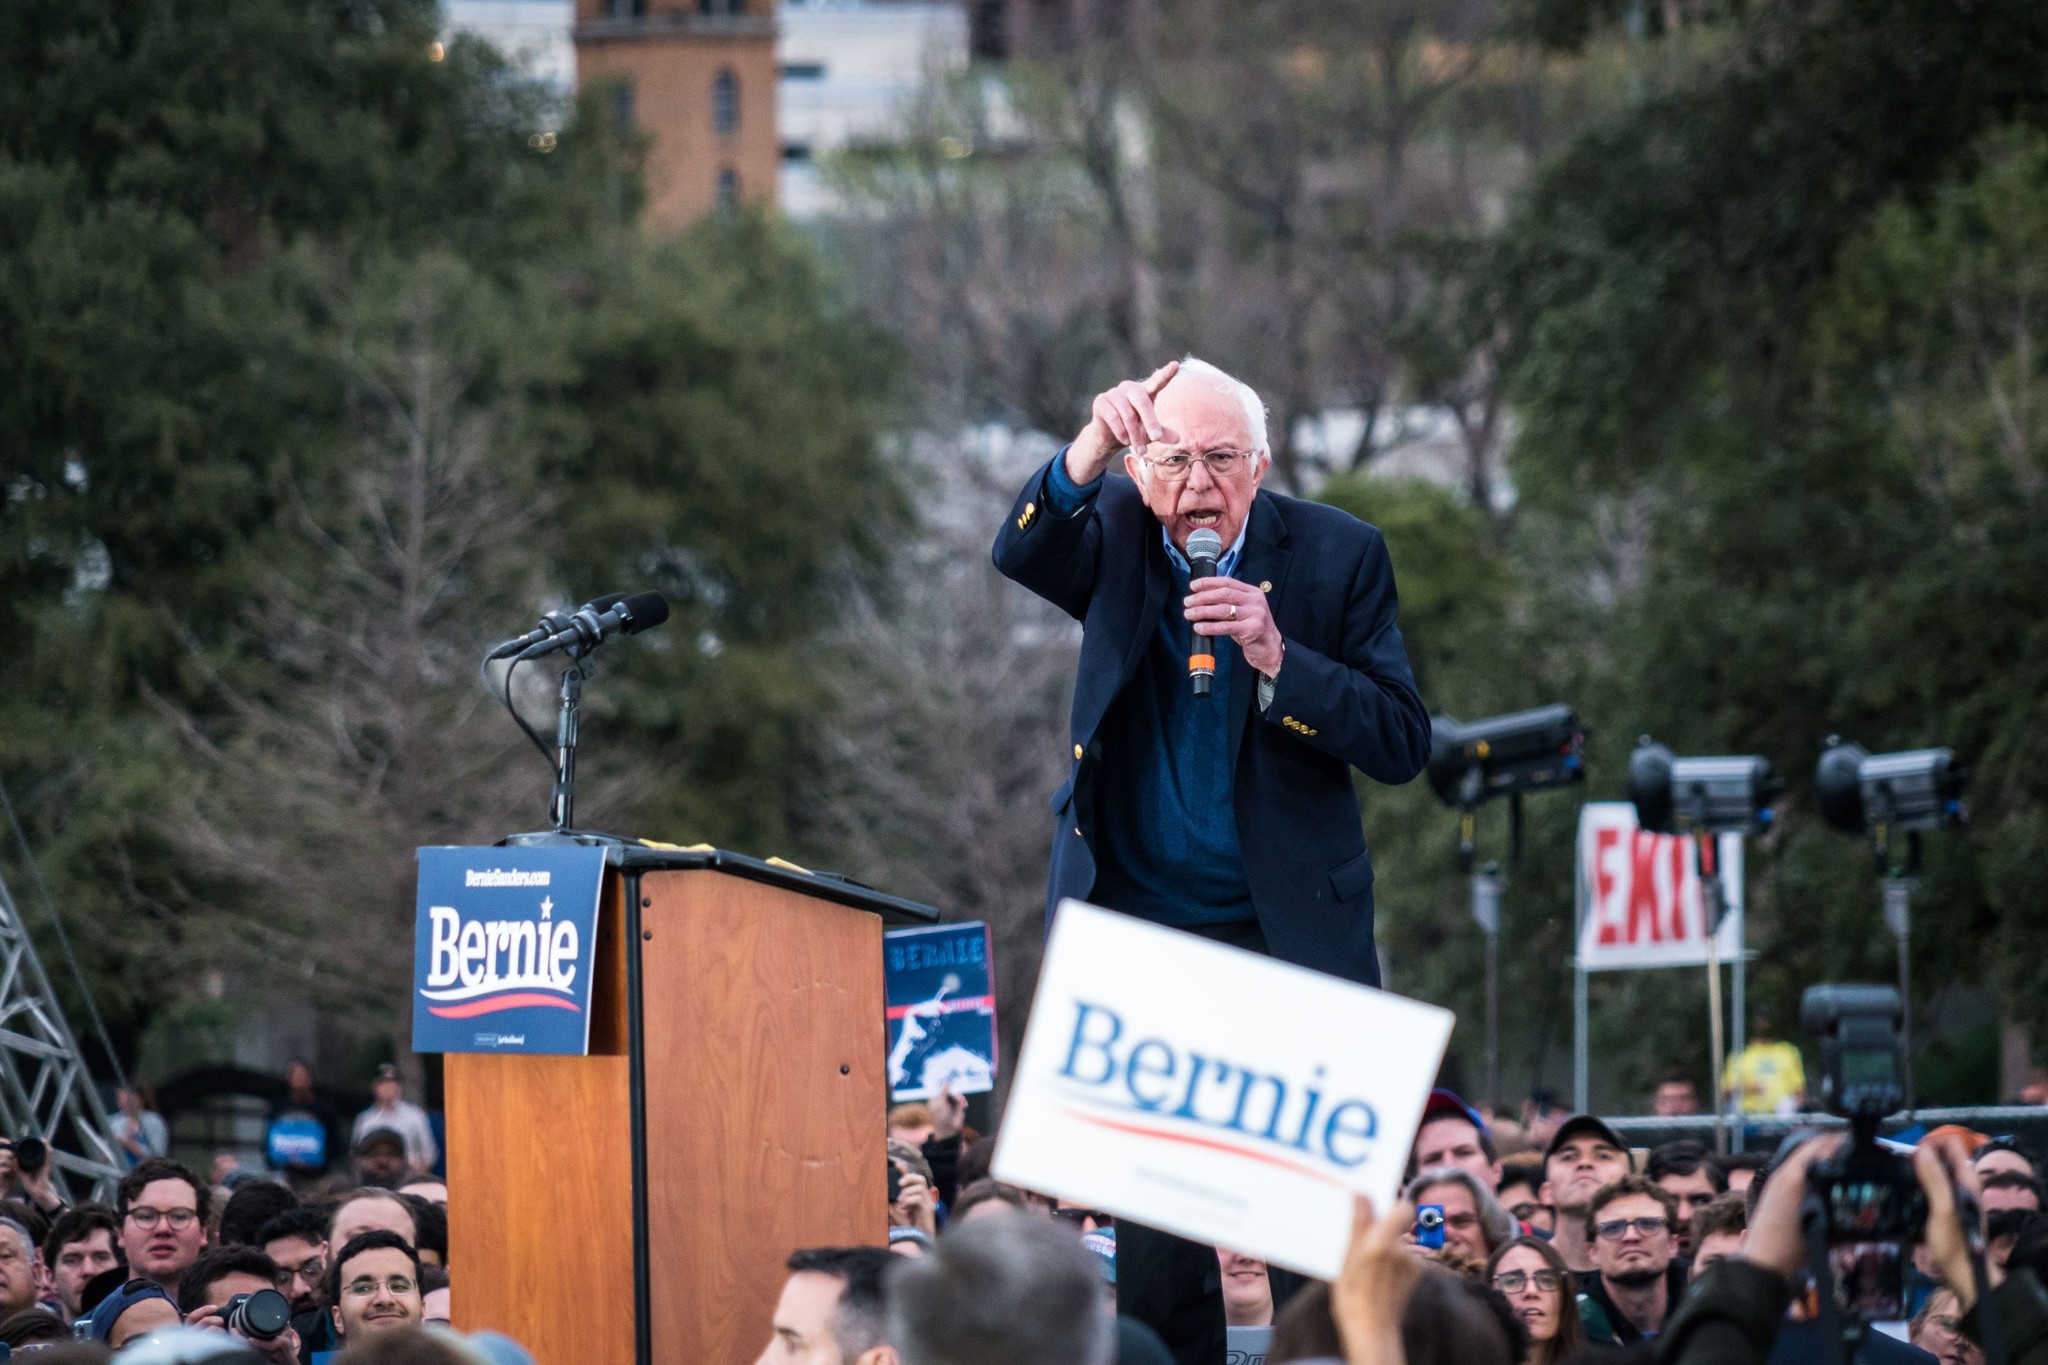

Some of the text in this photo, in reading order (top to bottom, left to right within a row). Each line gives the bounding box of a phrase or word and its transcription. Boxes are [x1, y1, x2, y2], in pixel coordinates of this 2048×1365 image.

[426, 896, 579, 988] Bernie
[889, 935, 984, 971] BERNIE
[1058, 1001, 1380, 1168] Bernie
